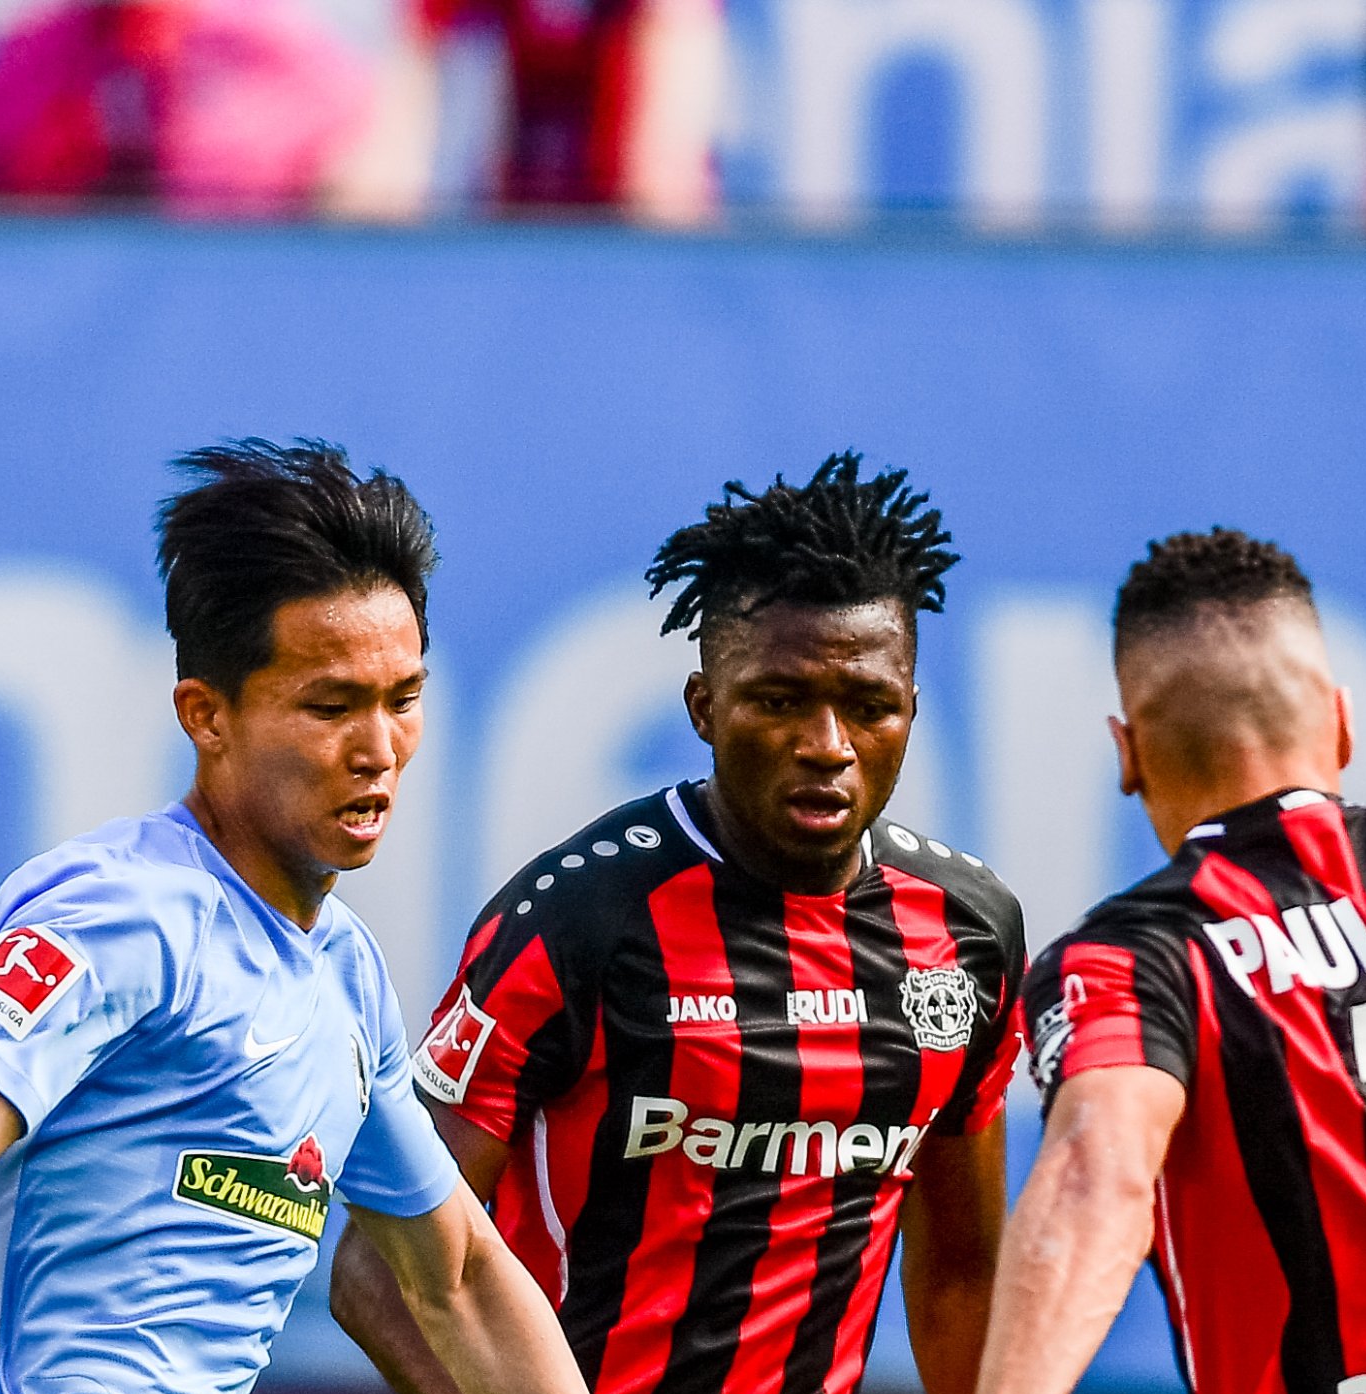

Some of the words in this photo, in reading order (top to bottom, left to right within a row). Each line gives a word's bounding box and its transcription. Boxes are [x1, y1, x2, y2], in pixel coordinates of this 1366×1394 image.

[666, 995, 737, 1023] JAKO
[796, 988, 869, 1025] RUDI
[416, 1054, 456, 1099] DESLIGA
